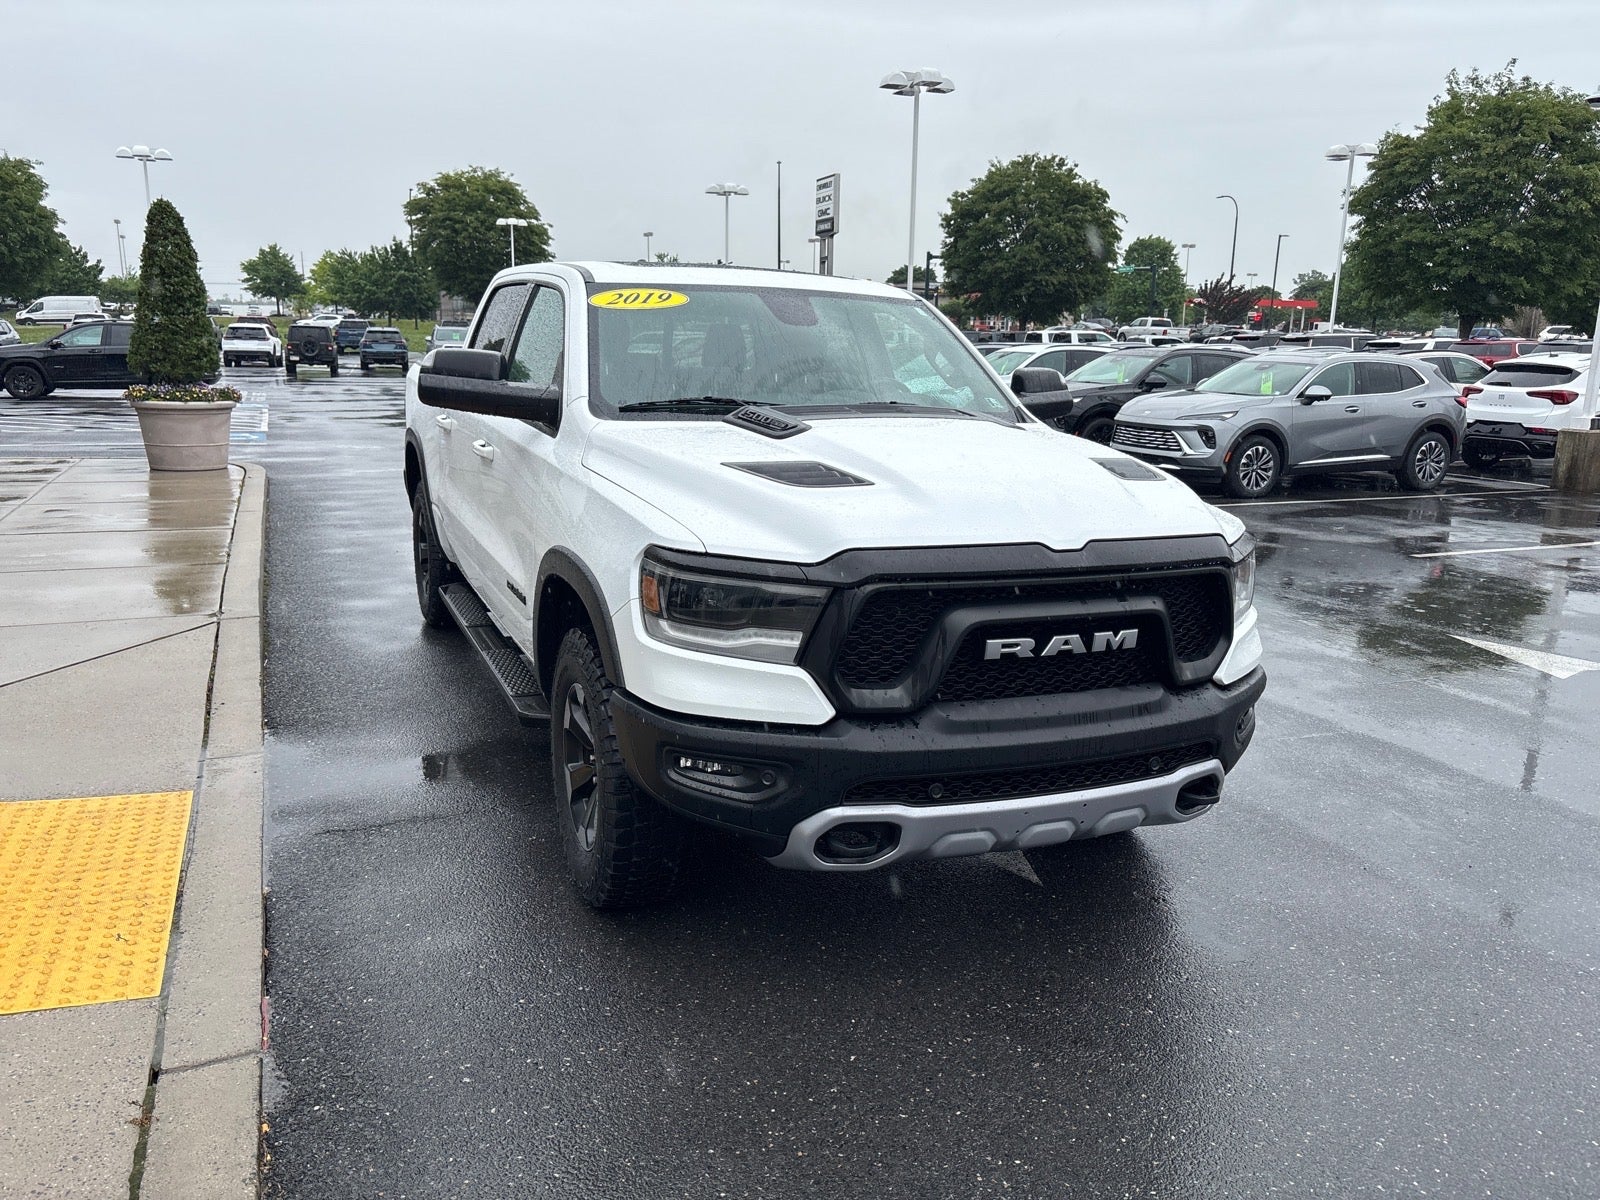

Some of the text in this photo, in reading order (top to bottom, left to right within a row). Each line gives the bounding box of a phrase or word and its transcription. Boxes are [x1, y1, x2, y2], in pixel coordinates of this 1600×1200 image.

[816, 194, 832, 204] BUICK
[818, 207, 831, 217] GMC
[605, 292, 672, 305] 2019
[984, 628, 1139, 660] RAM
